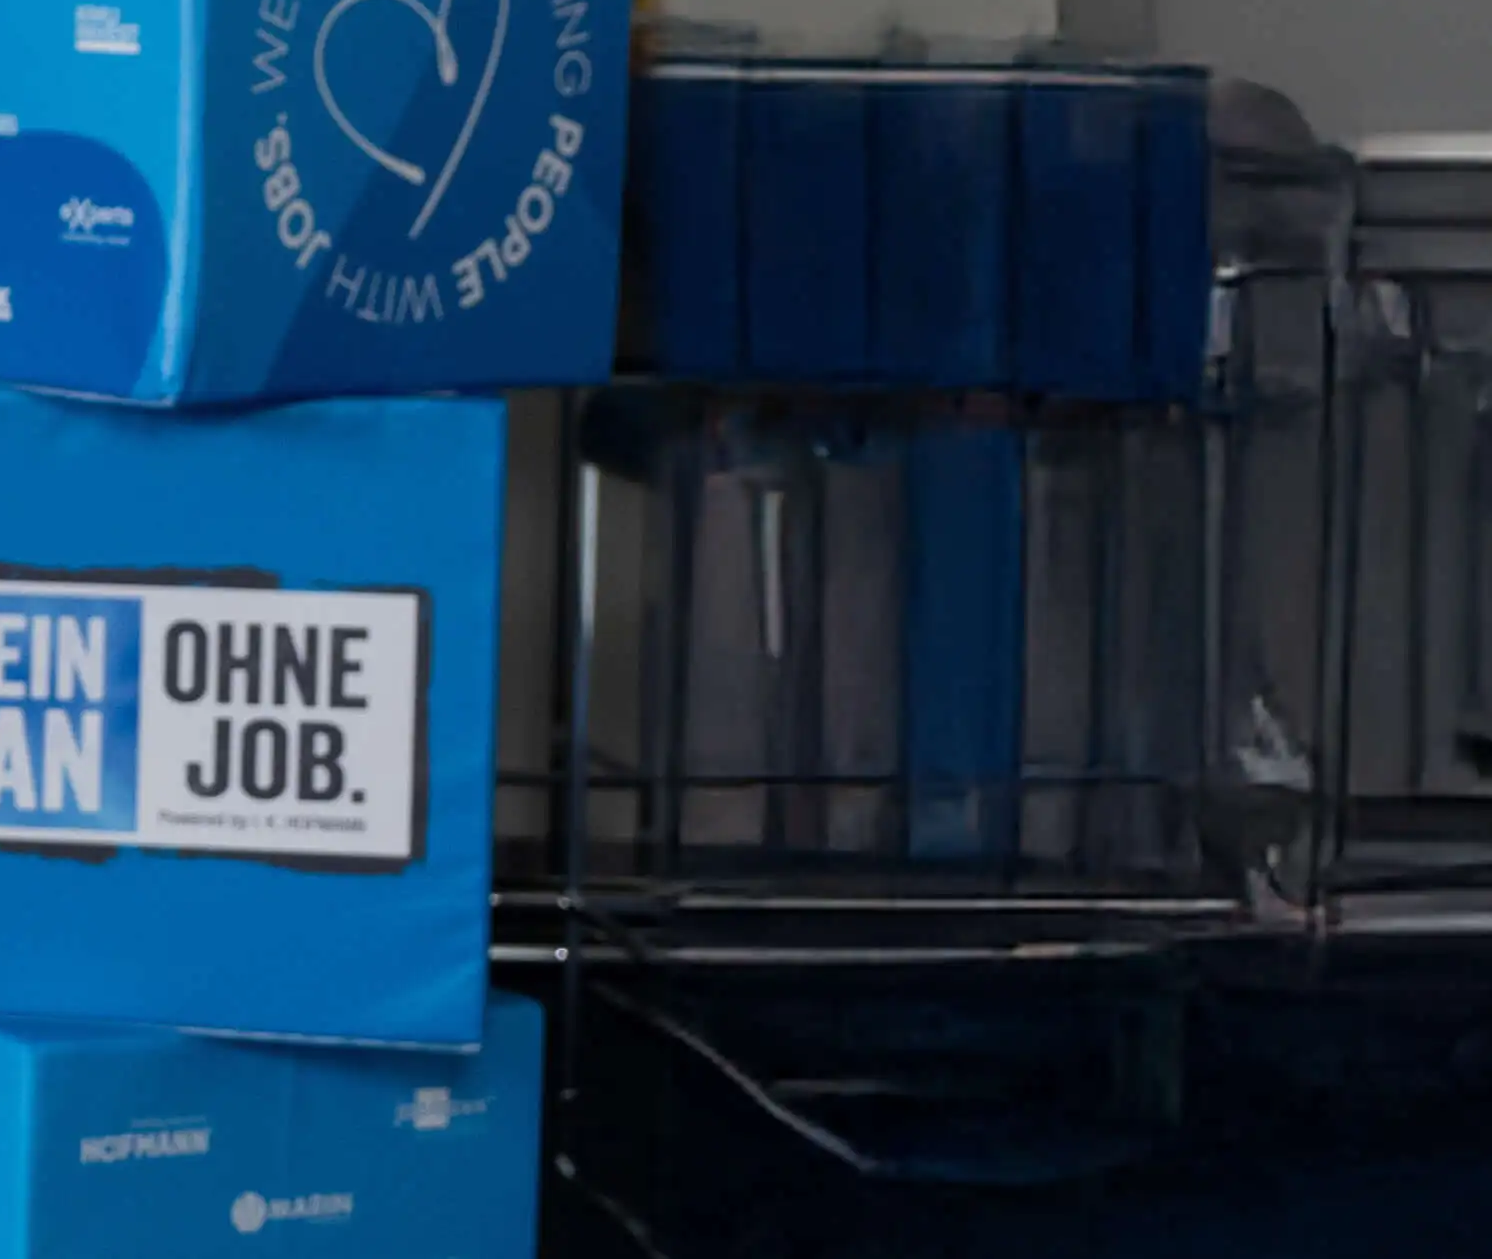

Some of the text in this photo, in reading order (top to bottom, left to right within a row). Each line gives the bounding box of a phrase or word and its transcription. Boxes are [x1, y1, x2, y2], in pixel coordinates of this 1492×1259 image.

[254, 111, 331, 269] JOBS.
[451, 113, 583, 308] PEOPLE
[326, 254, 444, 324] WITH
[163, 618, 370, 710] OHNE
[186, 717, 366, 805] JOB.
[80, 1130, 211, 1164] HOFMANN
